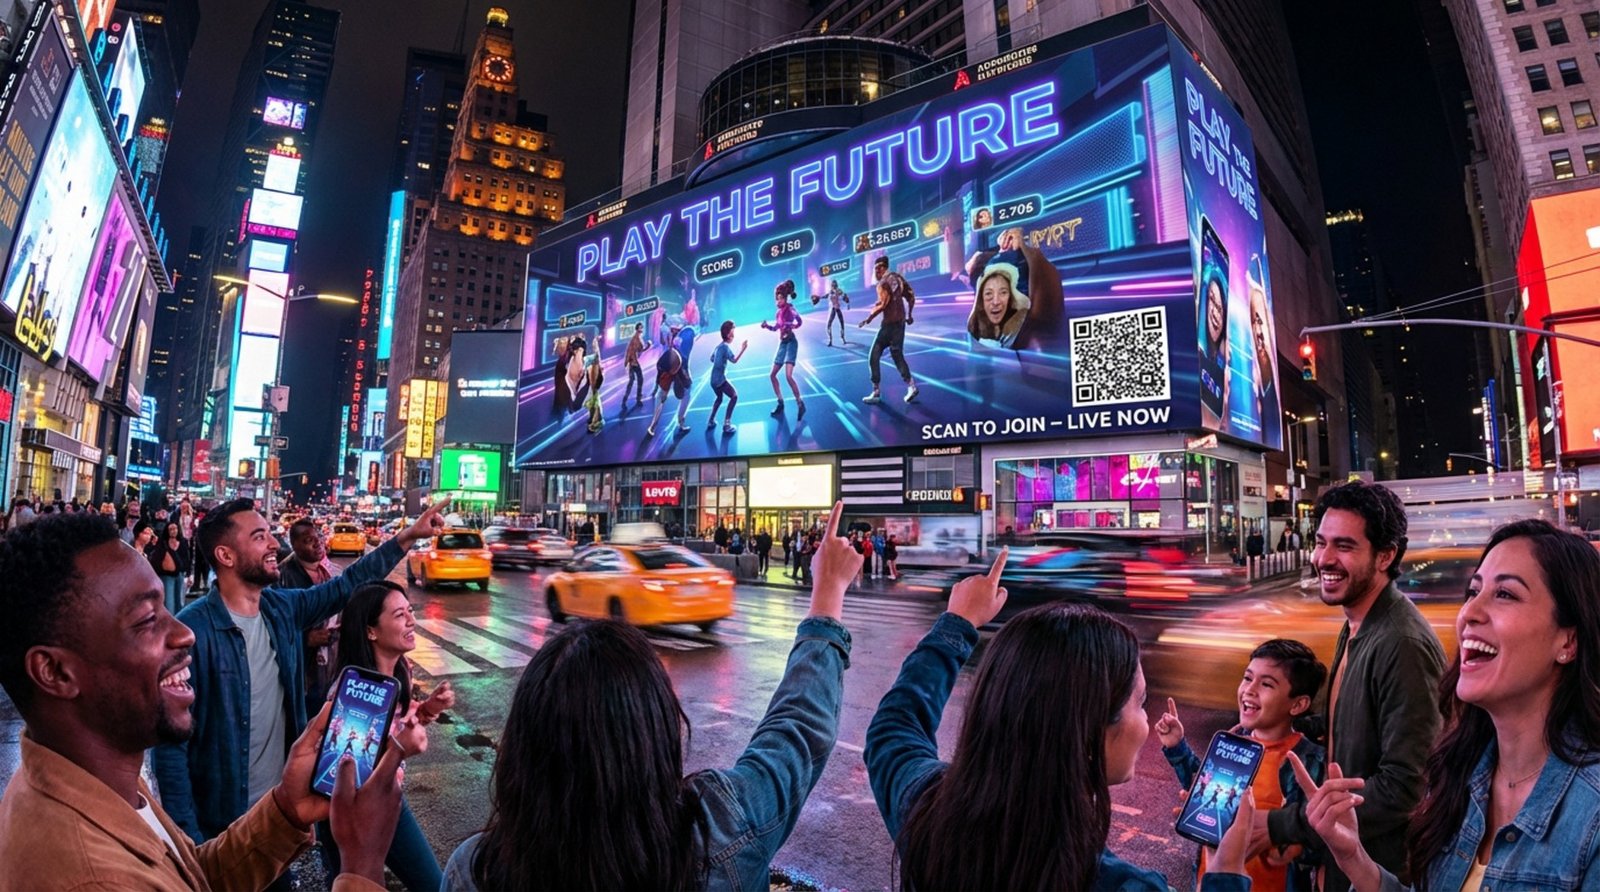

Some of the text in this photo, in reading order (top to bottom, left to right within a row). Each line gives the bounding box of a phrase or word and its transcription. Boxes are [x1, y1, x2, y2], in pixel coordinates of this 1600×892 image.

[577, 213, 672, 283] PLAY
[681, 176, 774, 247] THE
[791, 81, 1060, 215] FUTURE
[701, 257, 734, 276] SCORE
[921, 421, 968, 440] SCAN
[971, 420, 997, 437] TO
[1001, 416, 1046, 435] JOIN
[1067, 410, 1112, 430] LIVE
[1117, 406, 1171, 426] NOW
